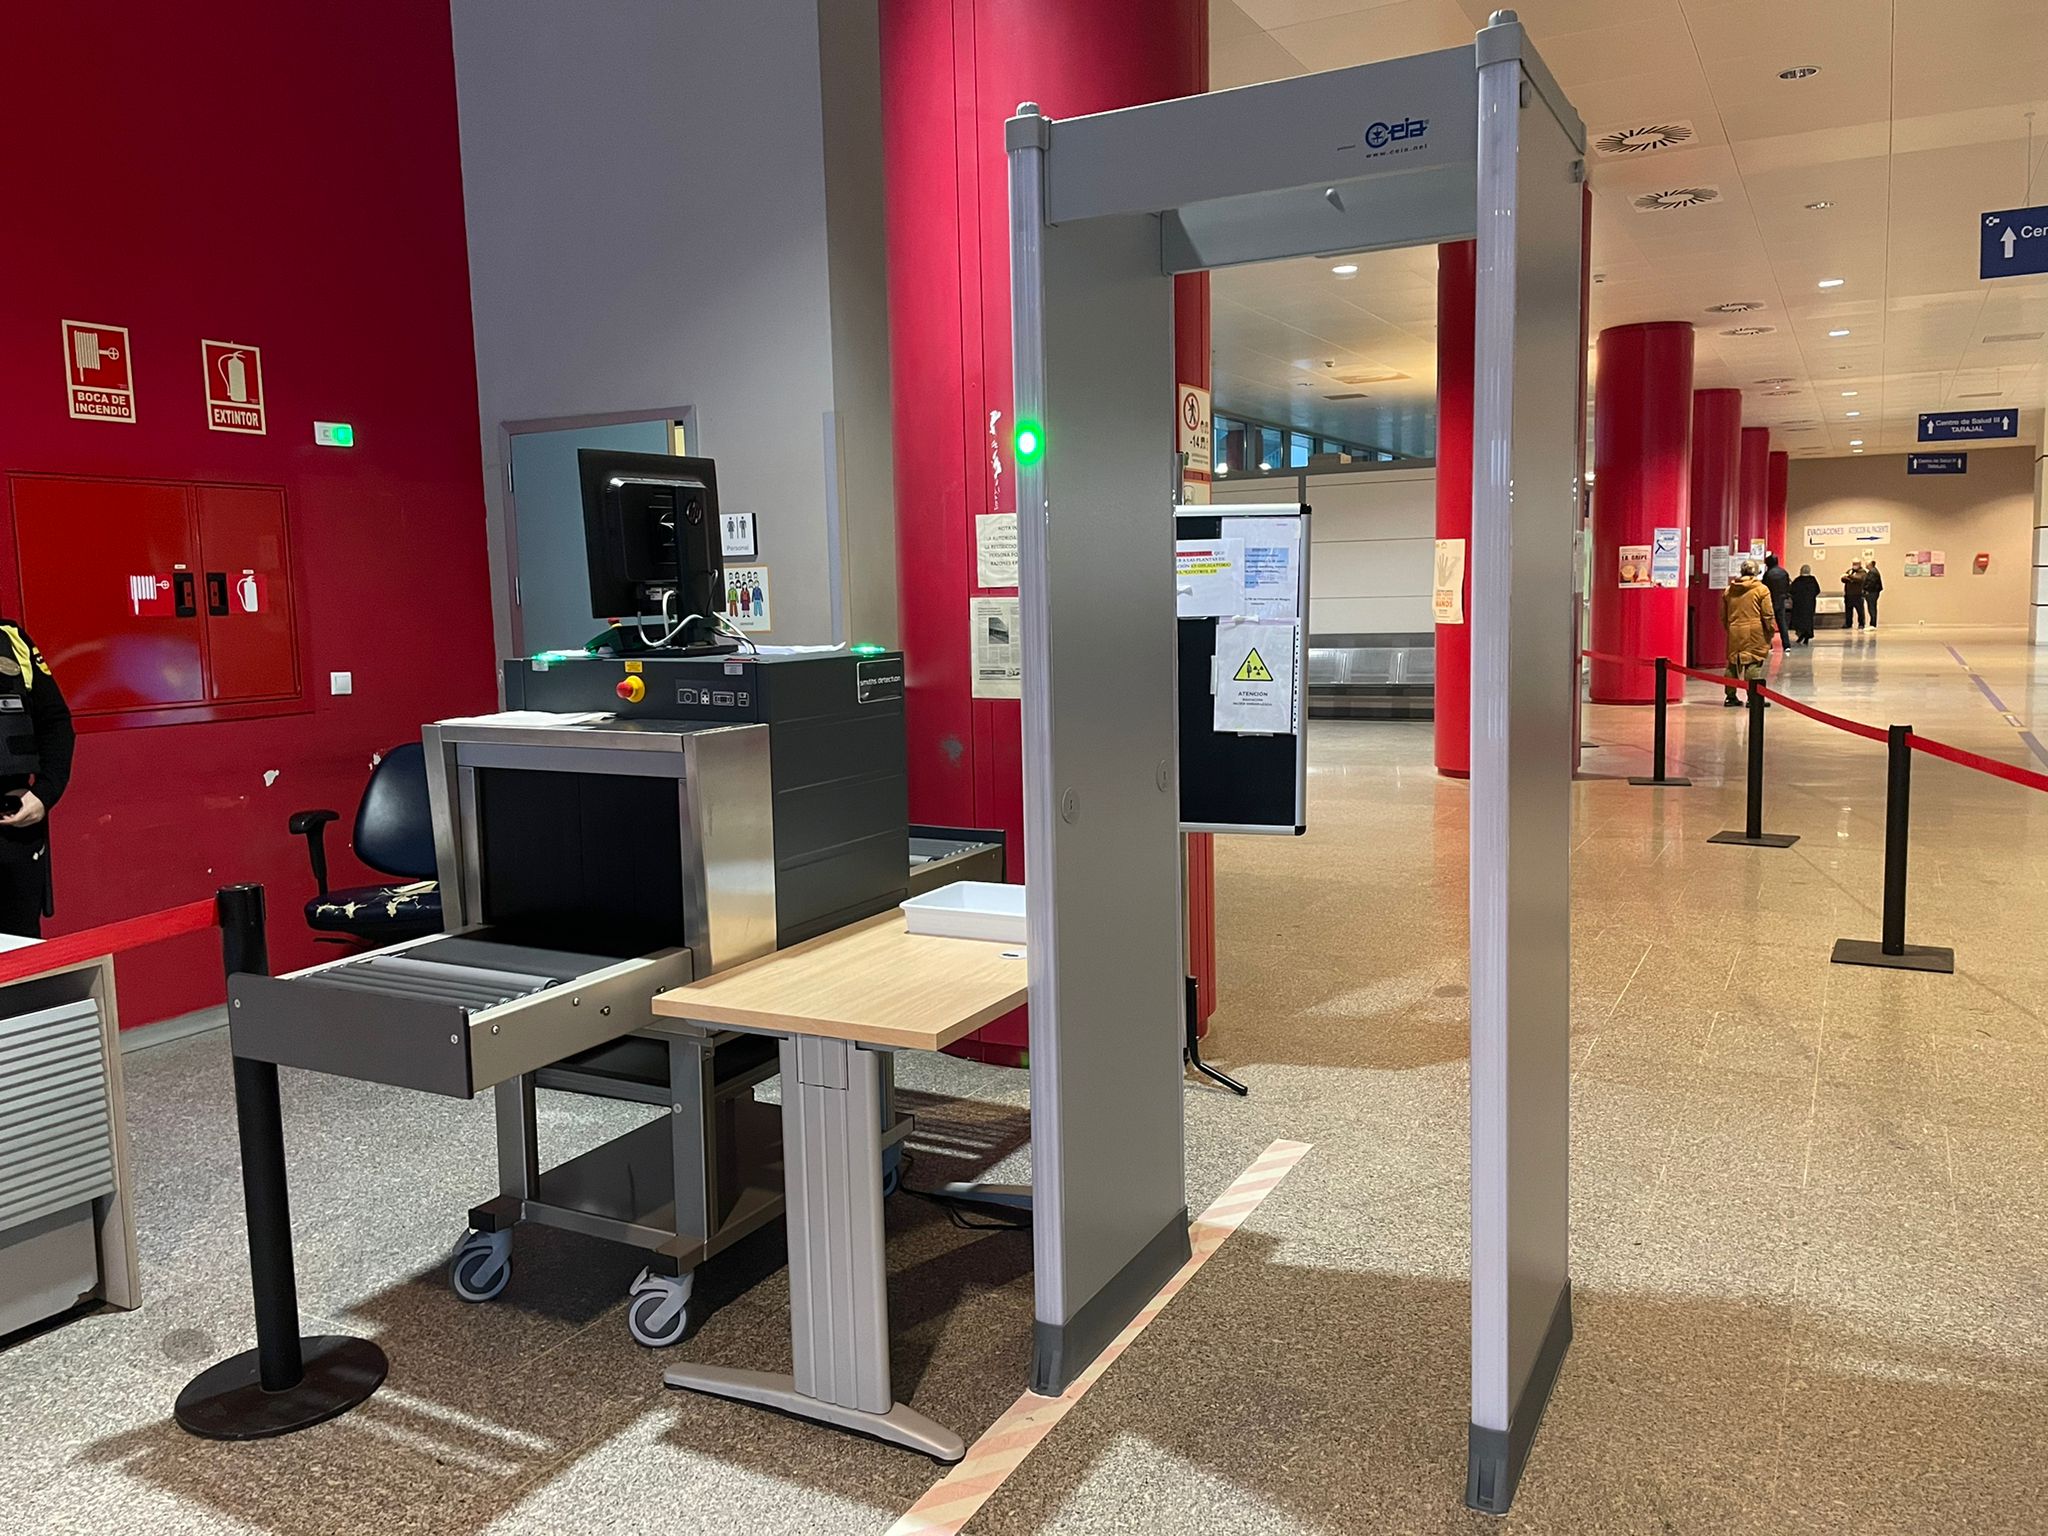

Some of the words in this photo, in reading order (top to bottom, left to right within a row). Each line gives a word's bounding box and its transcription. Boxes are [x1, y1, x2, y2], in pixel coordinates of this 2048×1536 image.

[1366, 143, 1428, 158] www.ceia.net
[78, 391, 109, 404] BOCA
[111, 395, 126, 405] DE
[75, 403, 130, 416] INCENDIO
[214, 408, 259, 427] EXTINTOR
[1971, 417, 1992, 425] Salud
